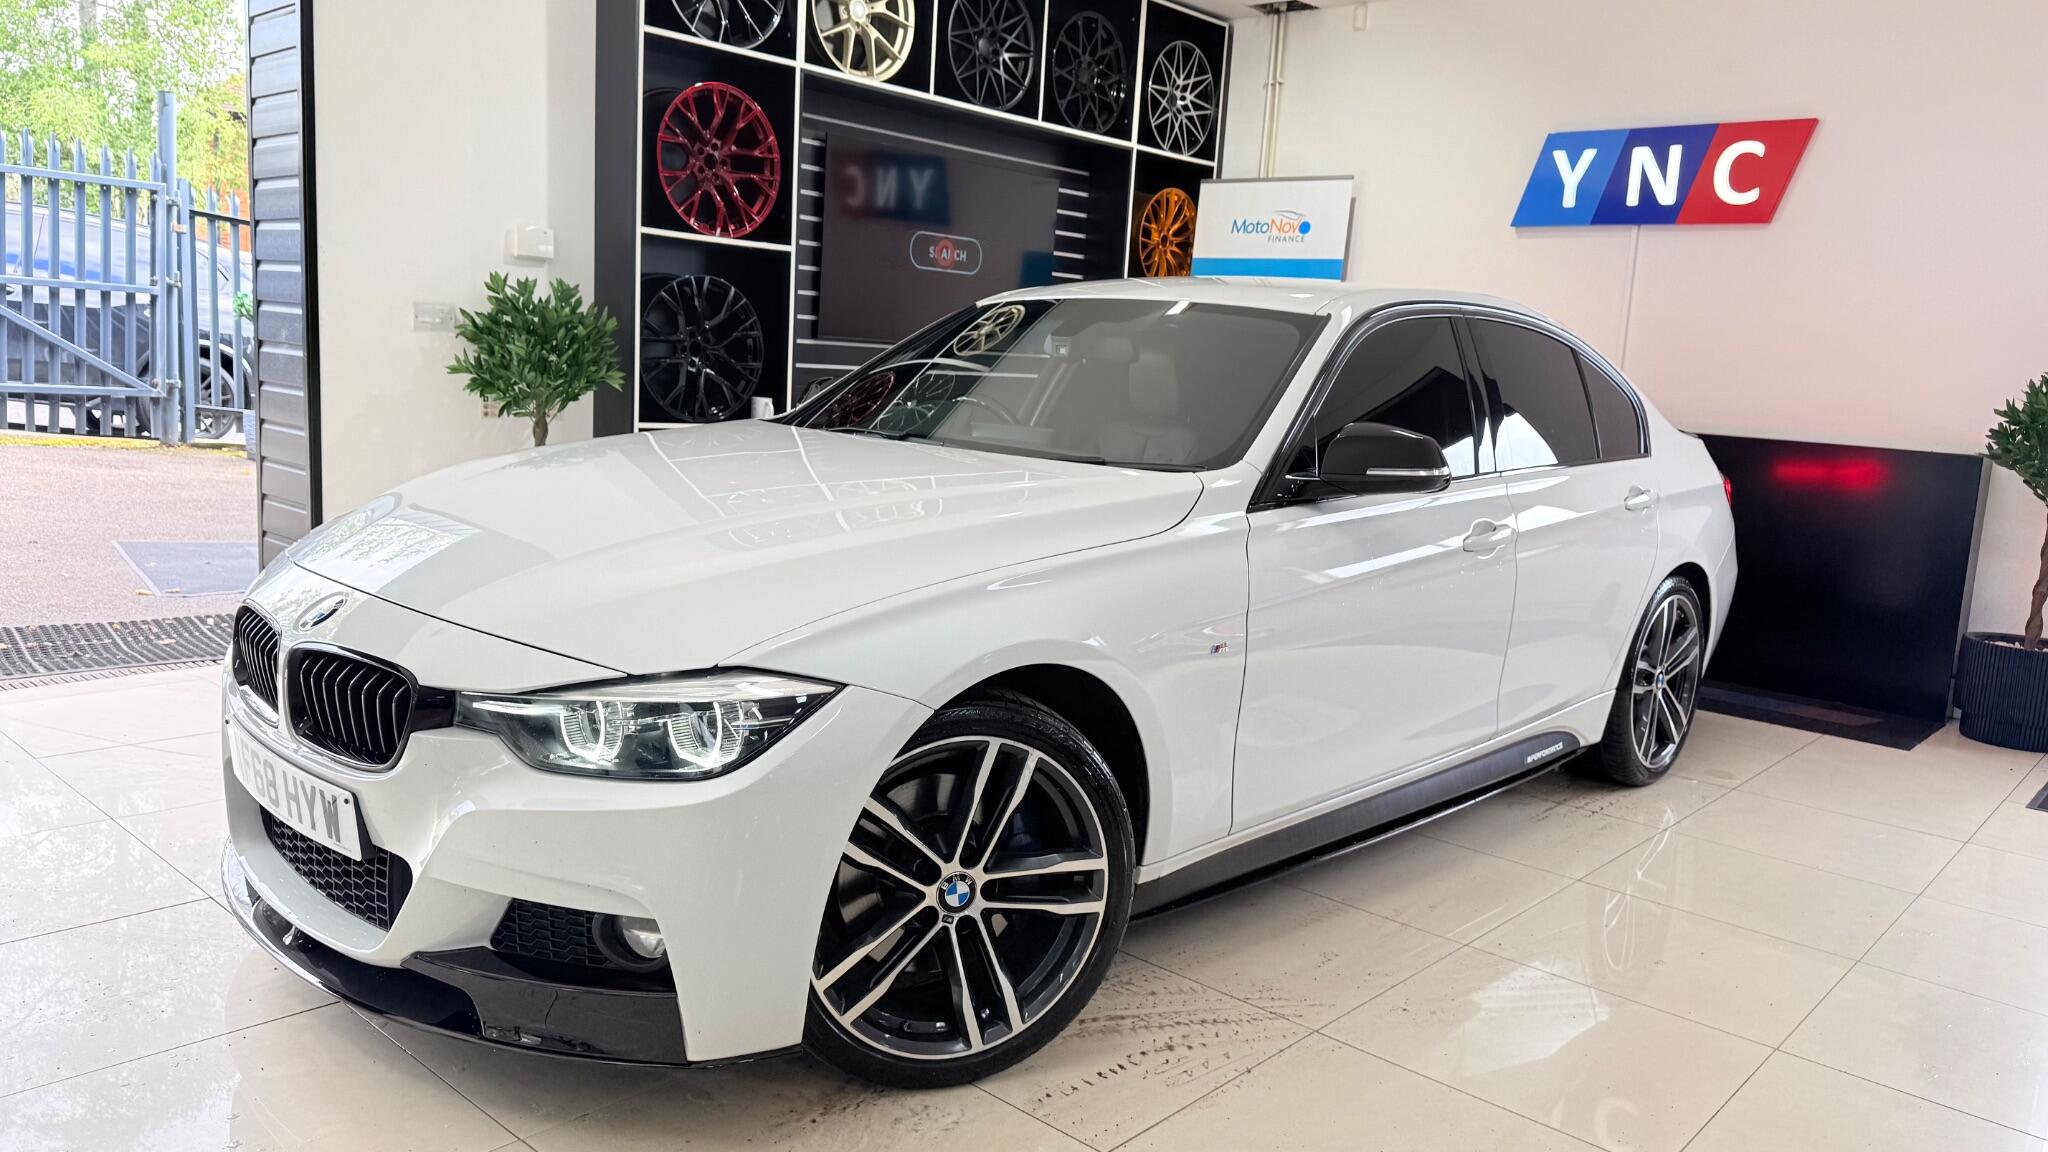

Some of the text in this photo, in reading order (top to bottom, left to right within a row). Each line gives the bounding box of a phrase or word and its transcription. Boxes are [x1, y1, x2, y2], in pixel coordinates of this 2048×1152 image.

[1552, 140, 1765, 208] YNC
[1267, 235, 1305, 243] FINANCE
[928, 246, 967, 263] SACH
[282, 769, 341, 843] HYW
[940, 873, 973, 890] BMW
